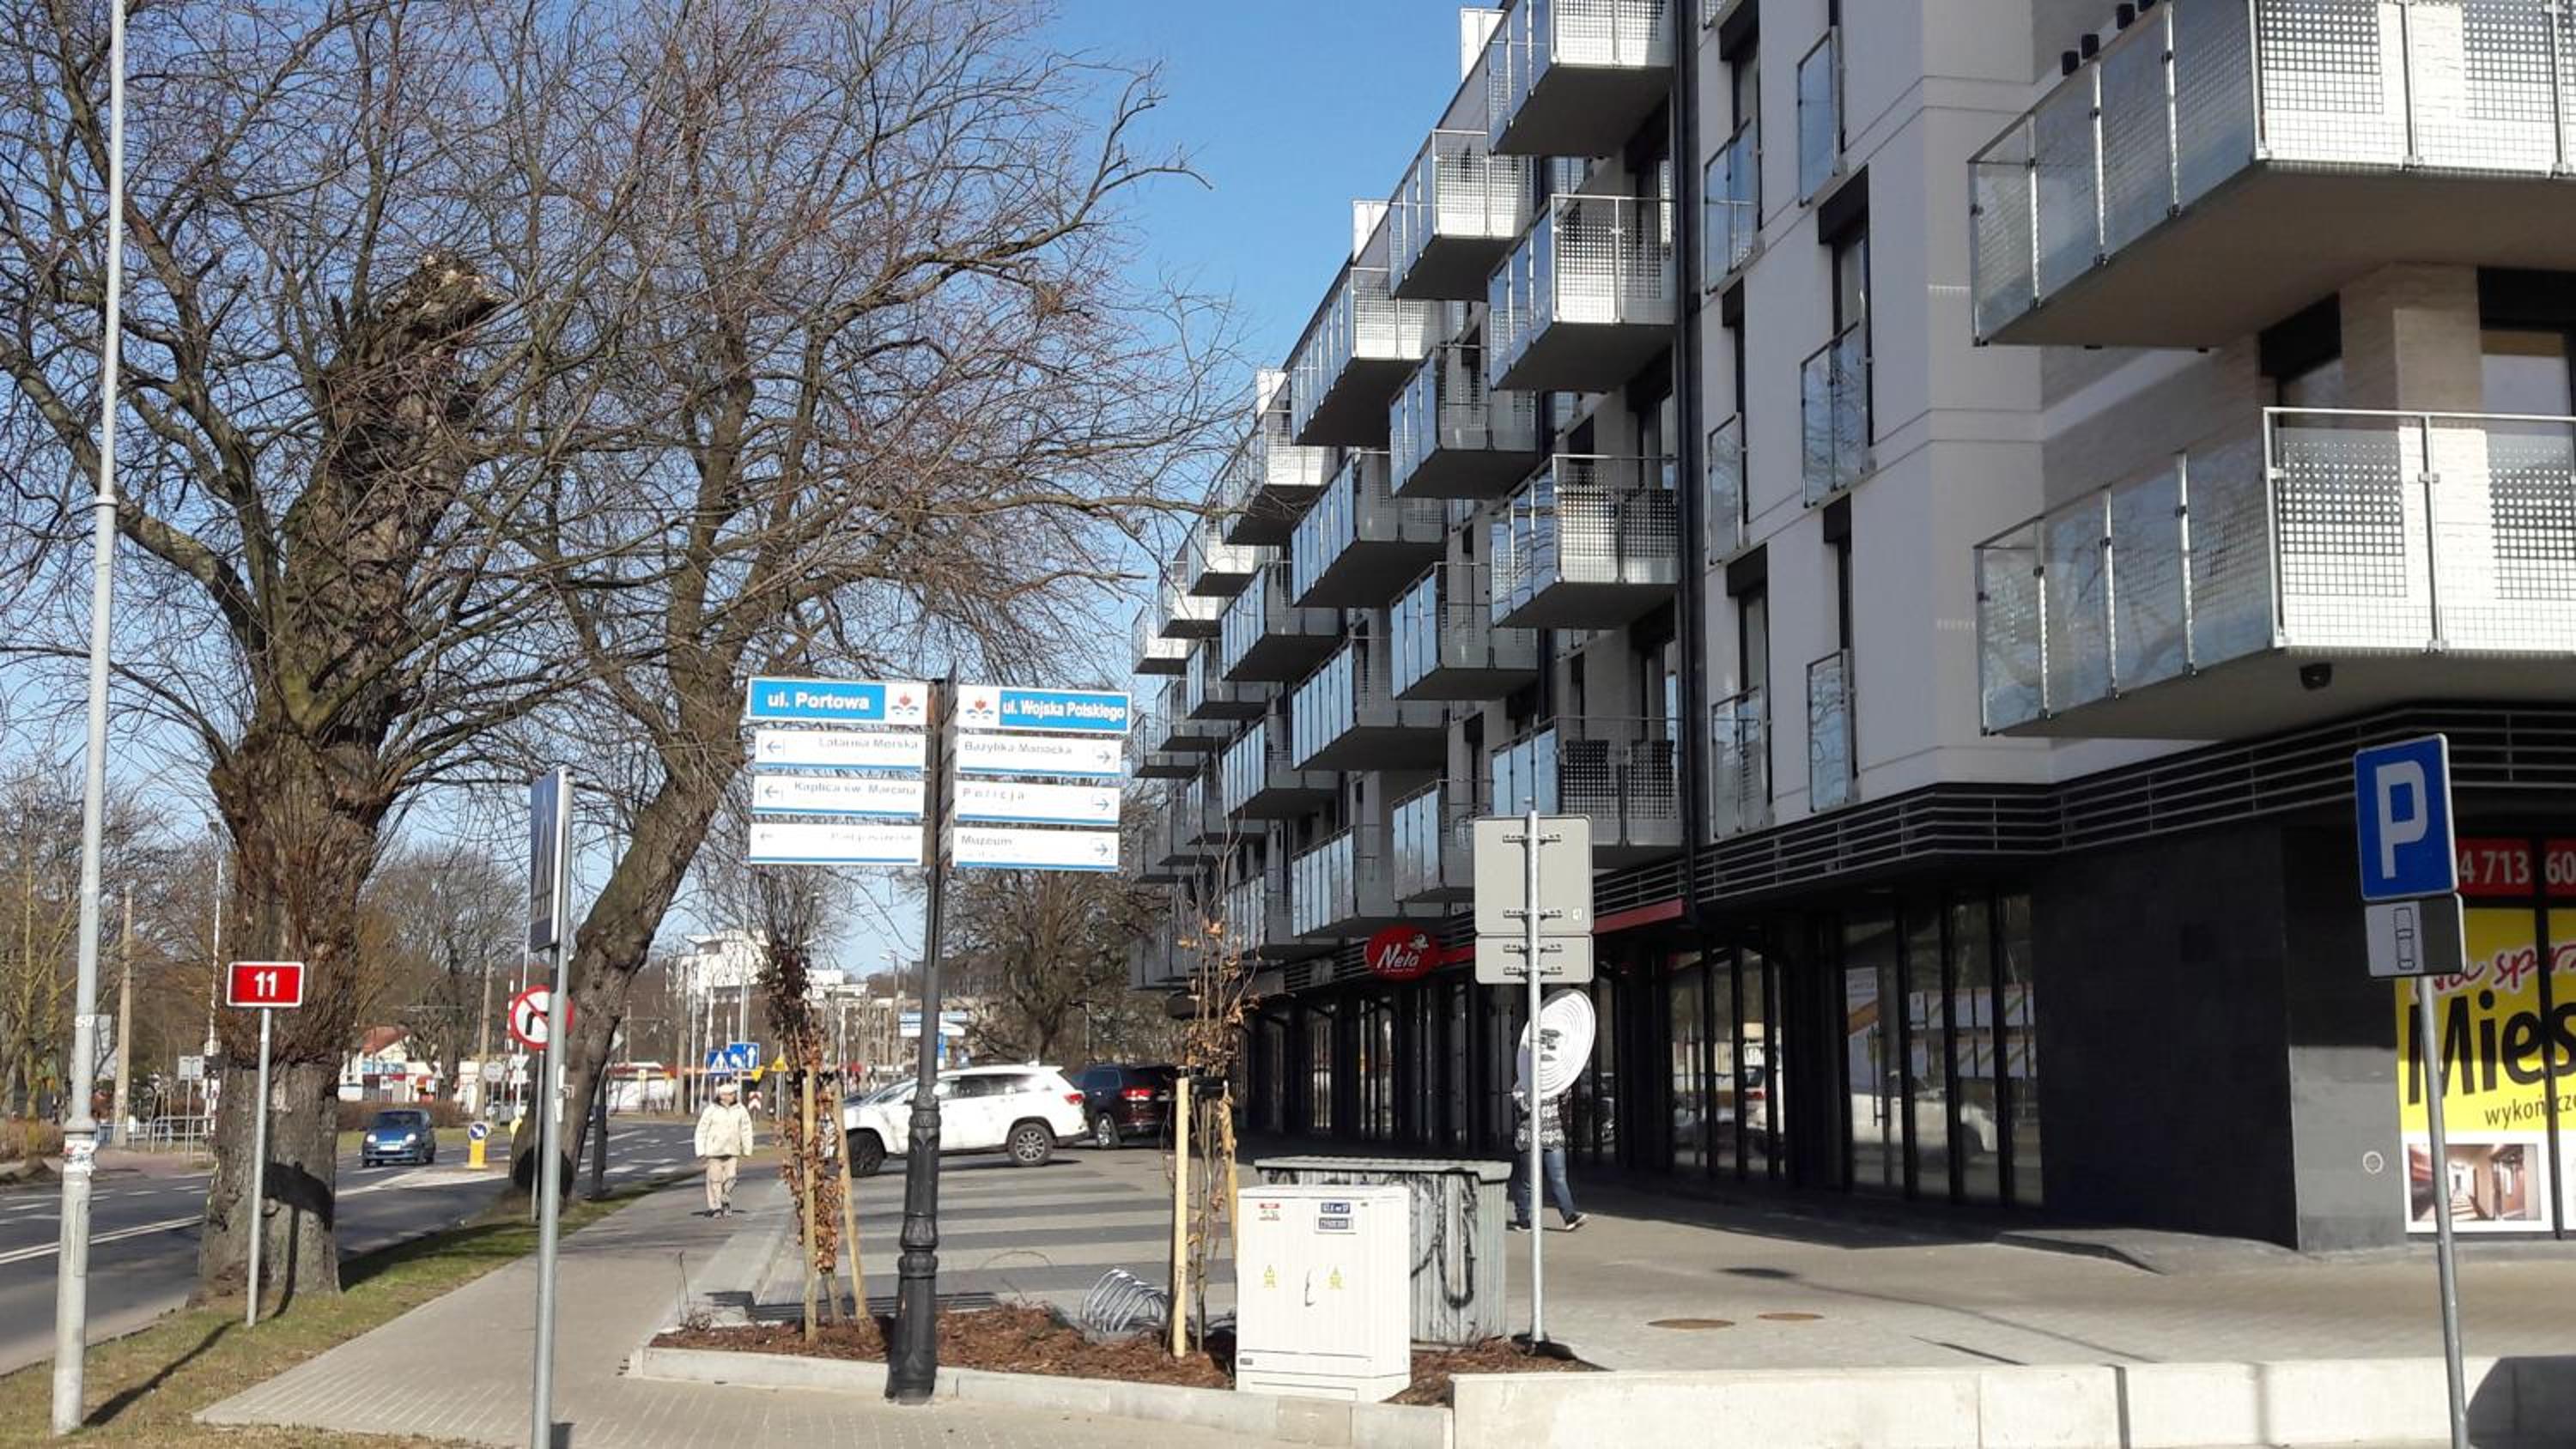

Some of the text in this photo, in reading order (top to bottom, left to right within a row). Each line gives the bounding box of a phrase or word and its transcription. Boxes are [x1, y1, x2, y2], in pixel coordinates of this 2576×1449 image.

[767, 692, 871, 711] ul. Portowa
[1003, 700, 1126, 723] ul. Wojska Polskiego
[2481, 850, 2530, 884] 713
[1376, 943, 1420, 969] Nela
[254, 971, 277, 997] 11
